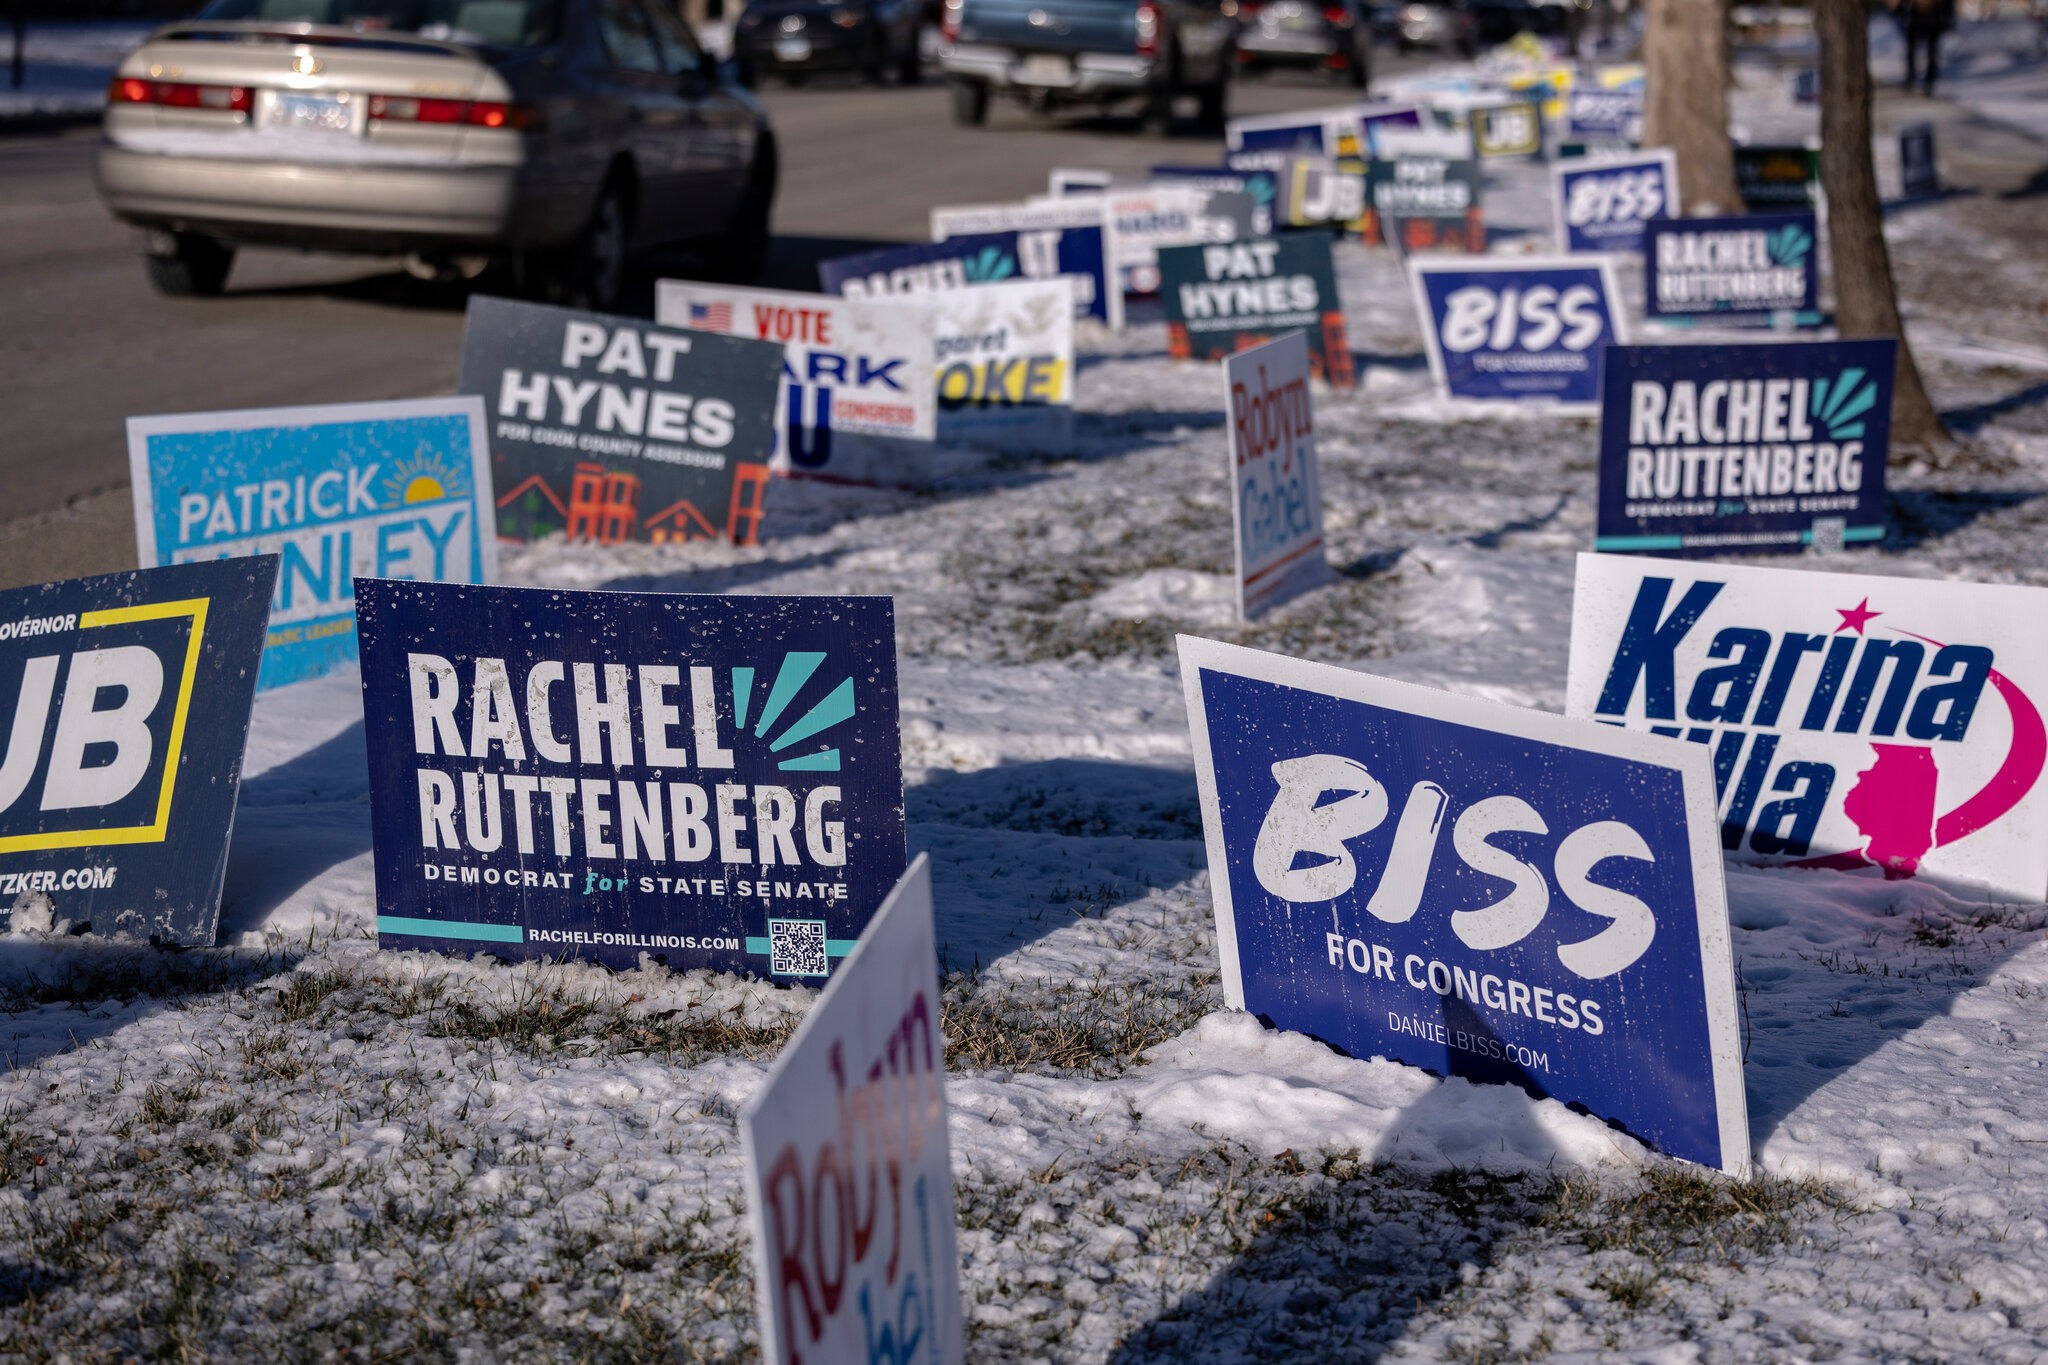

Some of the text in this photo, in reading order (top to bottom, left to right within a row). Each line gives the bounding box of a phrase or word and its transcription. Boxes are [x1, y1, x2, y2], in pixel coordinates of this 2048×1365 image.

[1568, 170, 1663, 228] BISS
[1203, 240, 1280, 281] PAT
[1656, 229, 1773, 269] RACHEL
[1179, 275, 1320, 319] HYNES
[1656, 267, 1807, 302] RUTTENBERG
[753, 303, 832, 346] VOTE
[1441, 285, 1604, 353] BISS
[562, 320, 692, 382] PAT
[498, 368, 736, 448] HYNES
[836, 401, 916, 425] CONGRESS
[1233, 364, 1312, 473] Robyn
[1630, 378, 1813, 444] RACHEL
[498, 421, 726, 470] FOR COOK COUNTY ASSESSOR
[1626, 441, 1865, 500] RUTTENBERG
[179, 463, 380, 543] PATRICK
[1243, 447, 1311, 562] Gabel
[1626, 496, 1860, 518] DEMOCRAT for STATE SENATE
[305, 618, 354, 641] LEADER
[1594, 576, 1995, 743] Karina
[407, 652, 735, 768] RACHEL
[417, 769, 848, 867] RUTTENBERG
[424, 864, 849, 900] DEMOCRAT for STATE SENATE
[1253, 753, 1656, 980] BISS
[528, 929, 740, 951] RACHELFORILLINOIS.COM
[1326, 932, 1605, 1036] FOR CONGRESS
[1387, 1012, 1550, 1072] DANIELBISS.COM
